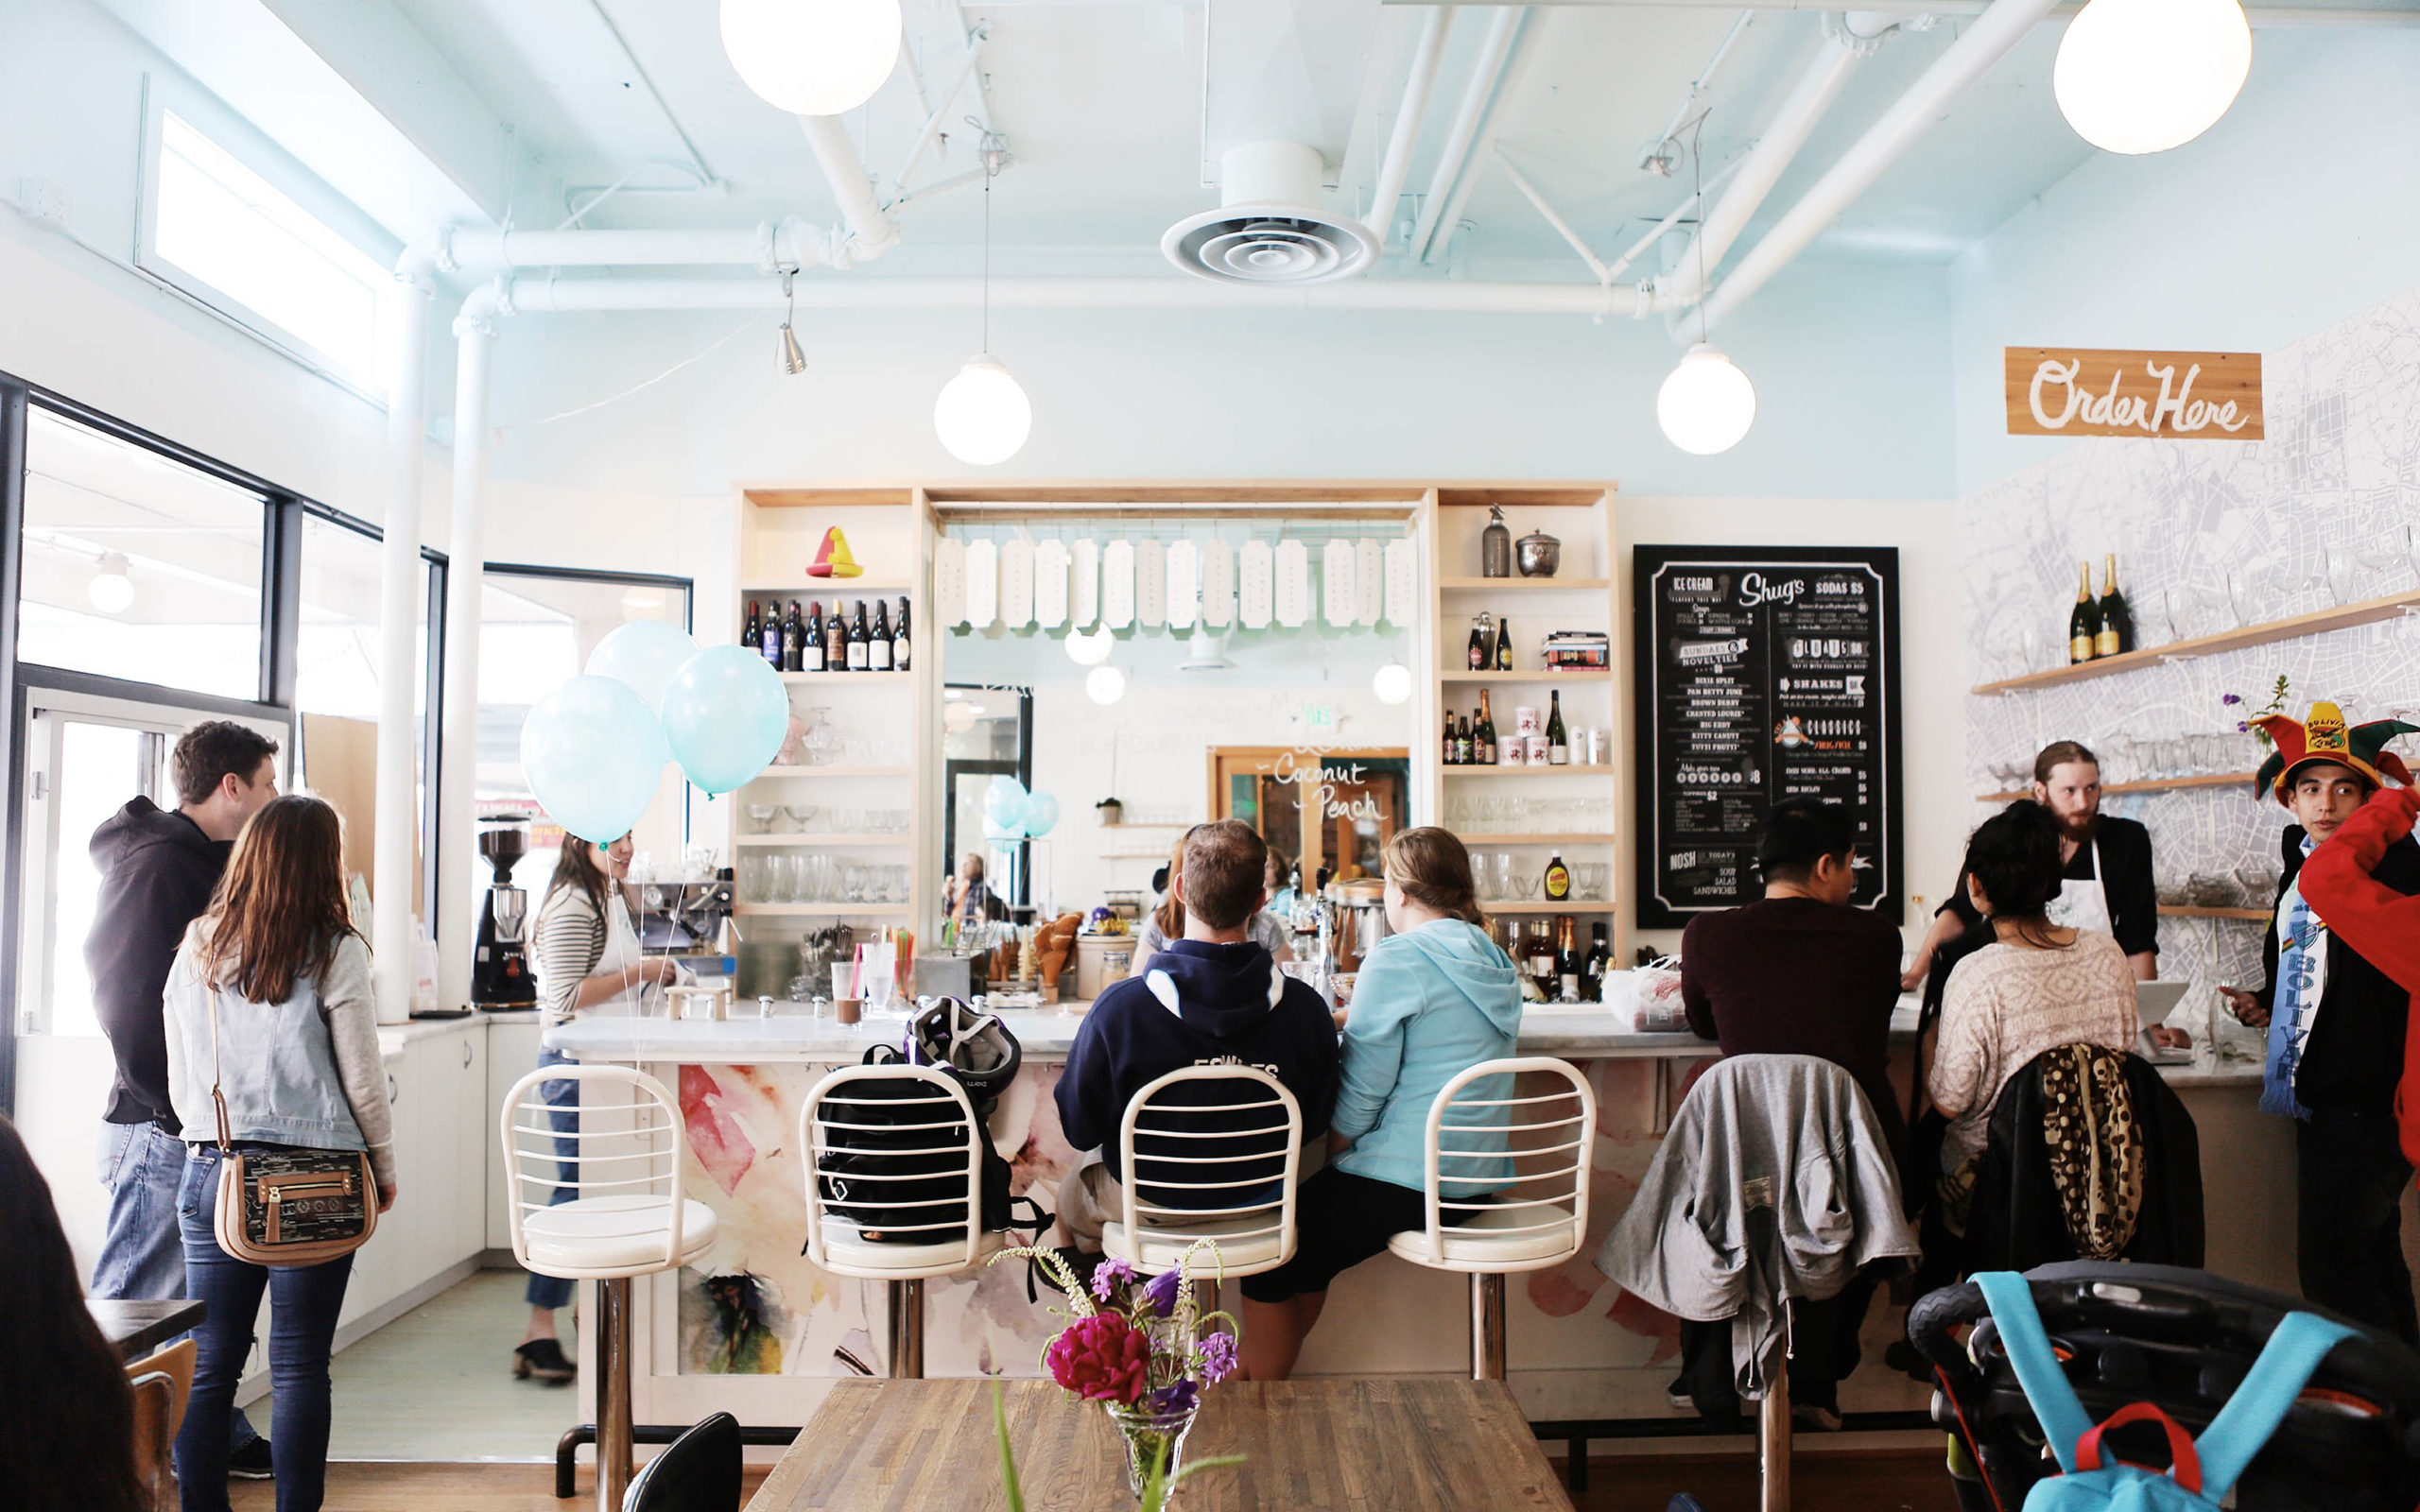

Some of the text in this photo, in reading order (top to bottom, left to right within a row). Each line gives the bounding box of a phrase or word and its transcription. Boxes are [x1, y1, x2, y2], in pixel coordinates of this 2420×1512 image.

[2030, 358, 2249, 432] Order Here
[1673, 576, 1713, 591] ICE CREAM
[1739, 572, 1805, 606] Shug's
[1815, 581, 1848, 594] SODAS
[1683, 645, 1726, 656] SUNDAES
[1793, 640, 1846, 657] FLOATS
[1683, 654, 1738, 666] NOVELTIES
[1793, 679, 1843, 689] SHAKES
[1807, 719, 1861, 735] CLASSICS
[1274, 752, 1368, 784] Coconut
[1707, 790, 1718, 801] $2
[1311, 784, 1389, 825] Peach
[1670, 850, 1696, 870] NOSH
[1720, 867, 1737, 876] SOUP
[1715, 876, 1737, 885] SALAD
[1693, 885, 1737, 896] SANDWICHES
